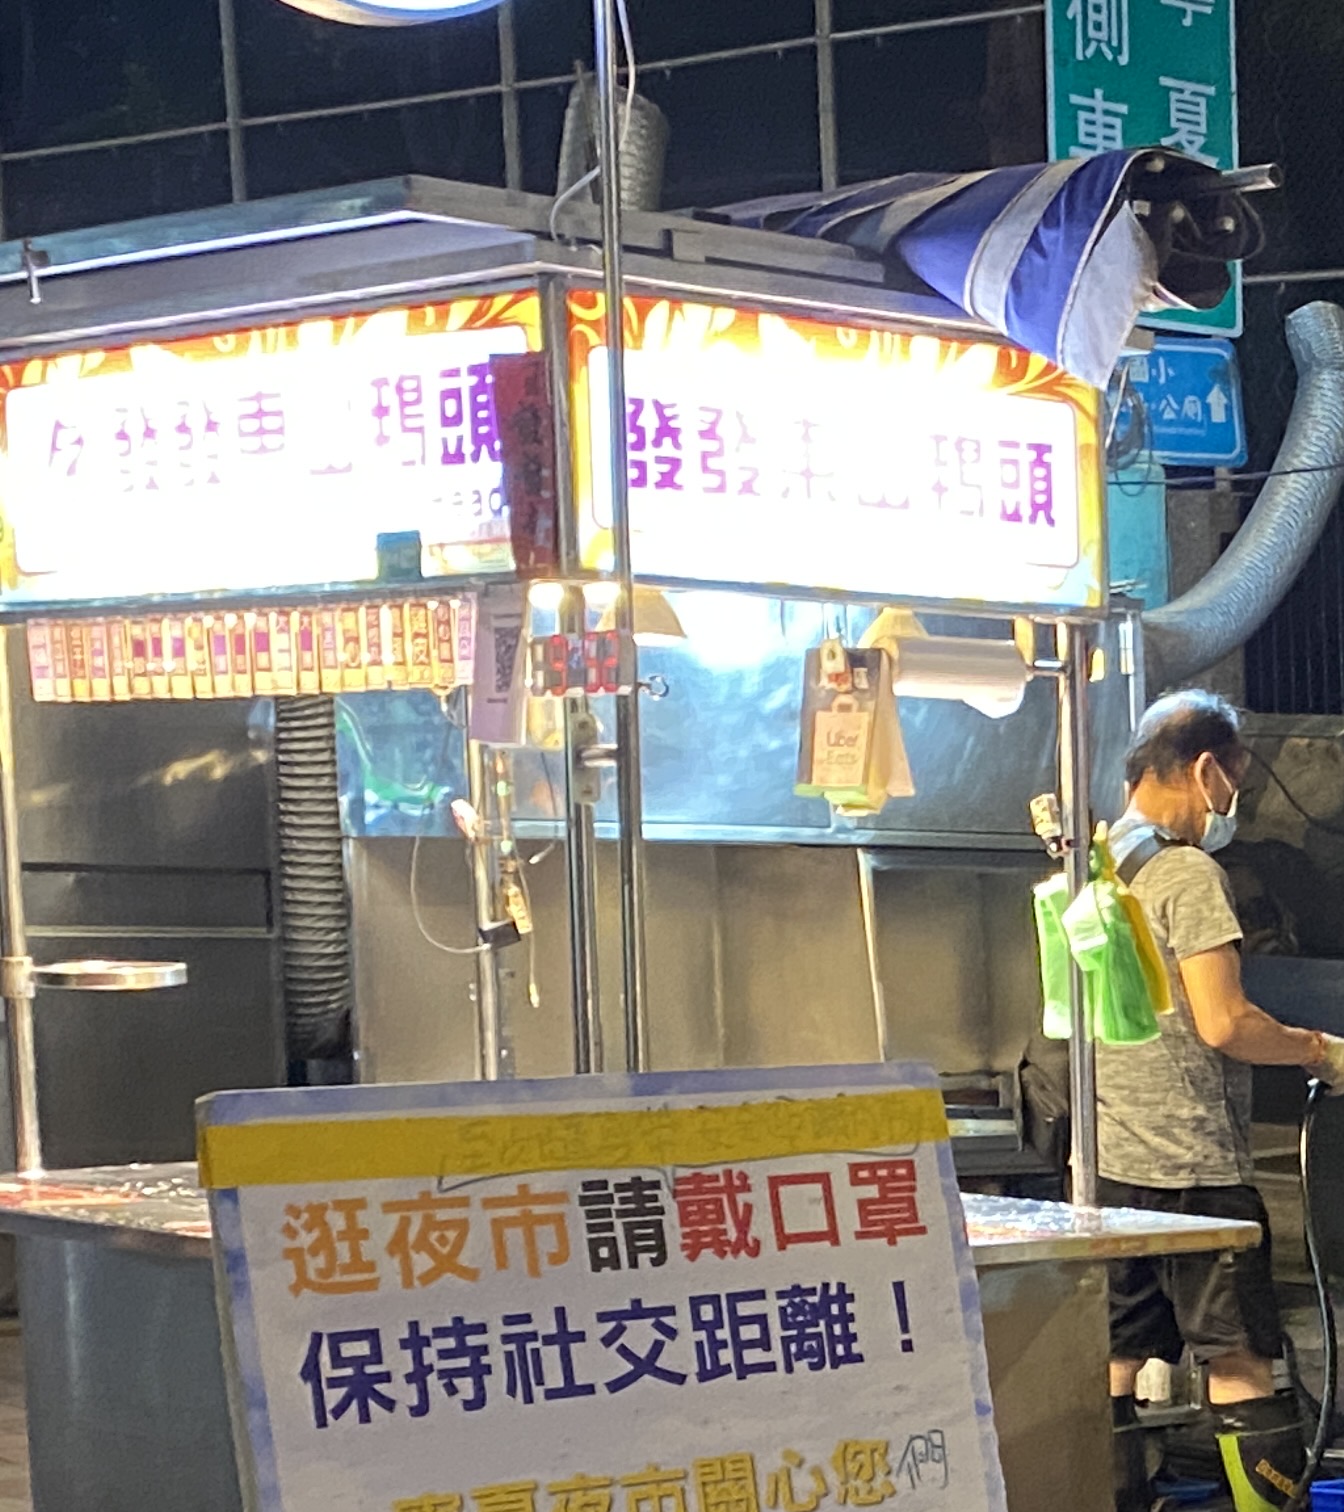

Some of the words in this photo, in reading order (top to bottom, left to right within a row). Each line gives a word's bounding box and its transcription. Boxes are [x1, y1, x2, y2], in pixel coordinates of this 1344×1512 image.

[280, 1159, 928, 1298] 逛夜市請戴口罩
[299, 1280, 918, 1429] 保持社交距離！
